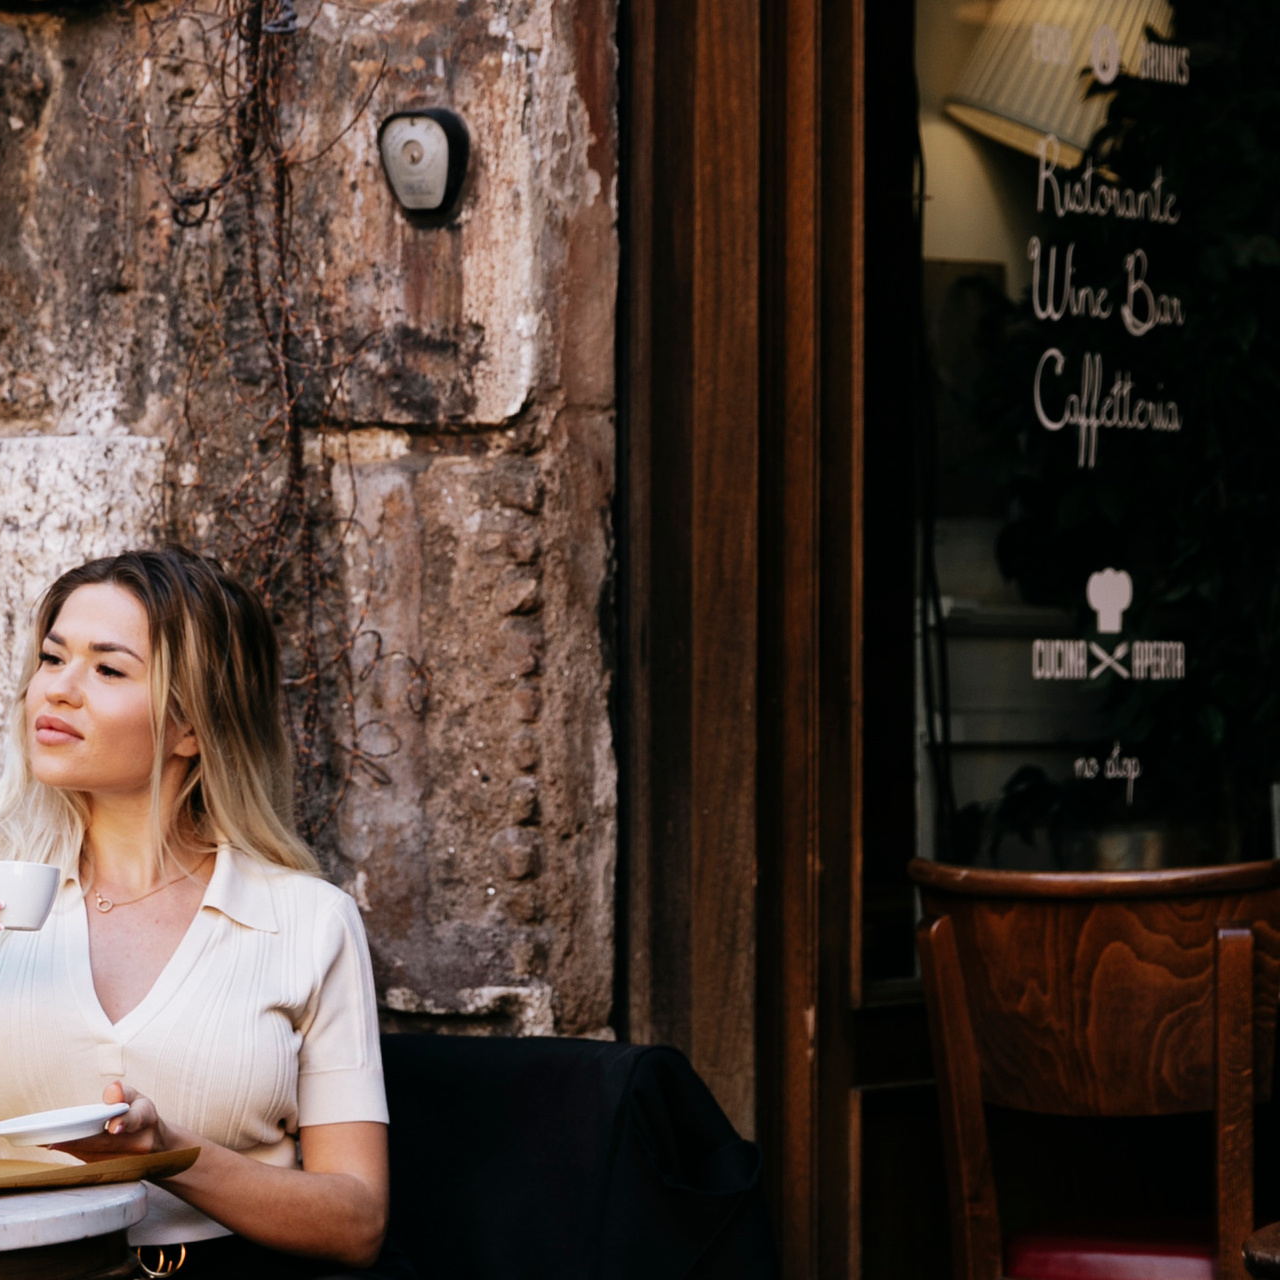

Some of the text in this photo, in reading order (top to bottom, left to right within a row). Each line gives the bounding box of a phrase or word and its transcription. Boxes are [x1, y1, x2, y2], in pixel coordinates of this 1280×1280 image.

[1035, 132, 1182, 225] Ristorante
[1027, 235, 1186, 338] Wine Bar
[1033, 347, 1183, 469] Caffetteria
[1032, 638, 1186, 680] CUCINA APERTA
